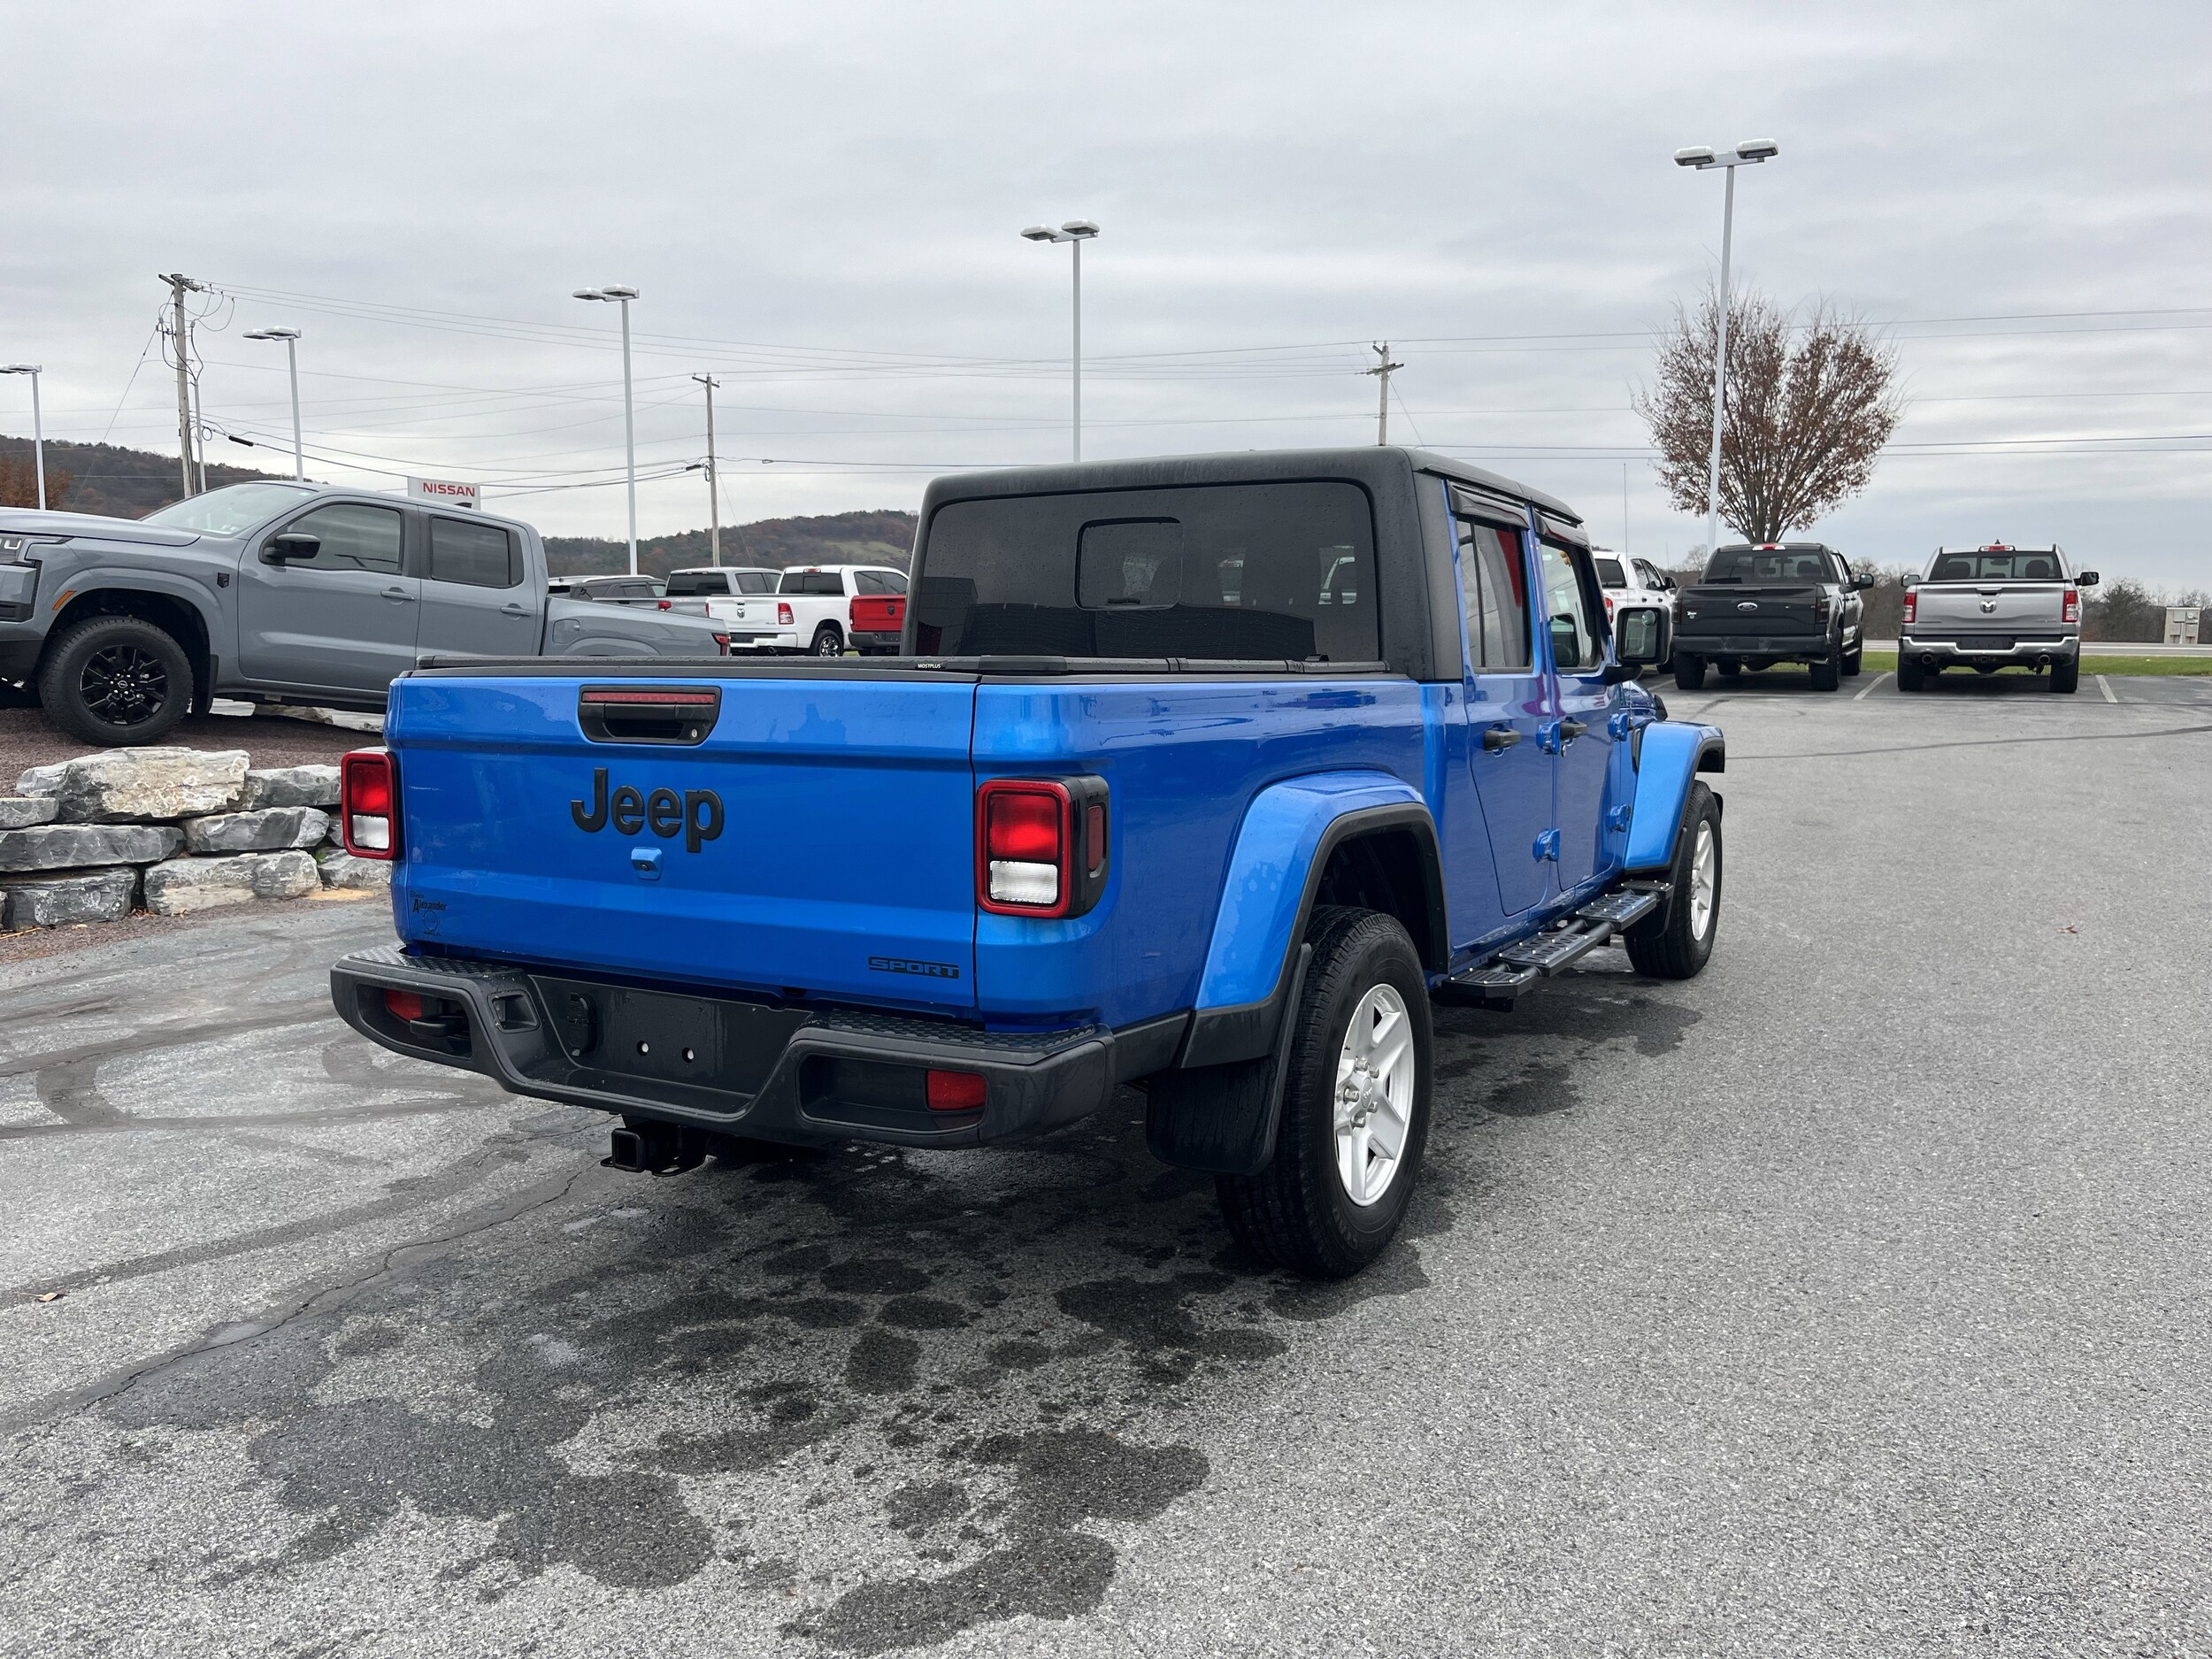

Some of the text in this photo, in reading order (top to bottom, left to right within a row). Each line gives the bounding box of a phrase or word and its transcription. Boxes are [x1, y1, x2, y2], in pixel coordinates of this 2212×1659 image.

[423, 482, 475, 497] NISSAN
[571, 767, 725, 853] Jeep
[869, 958, 960, 977] SPORT
